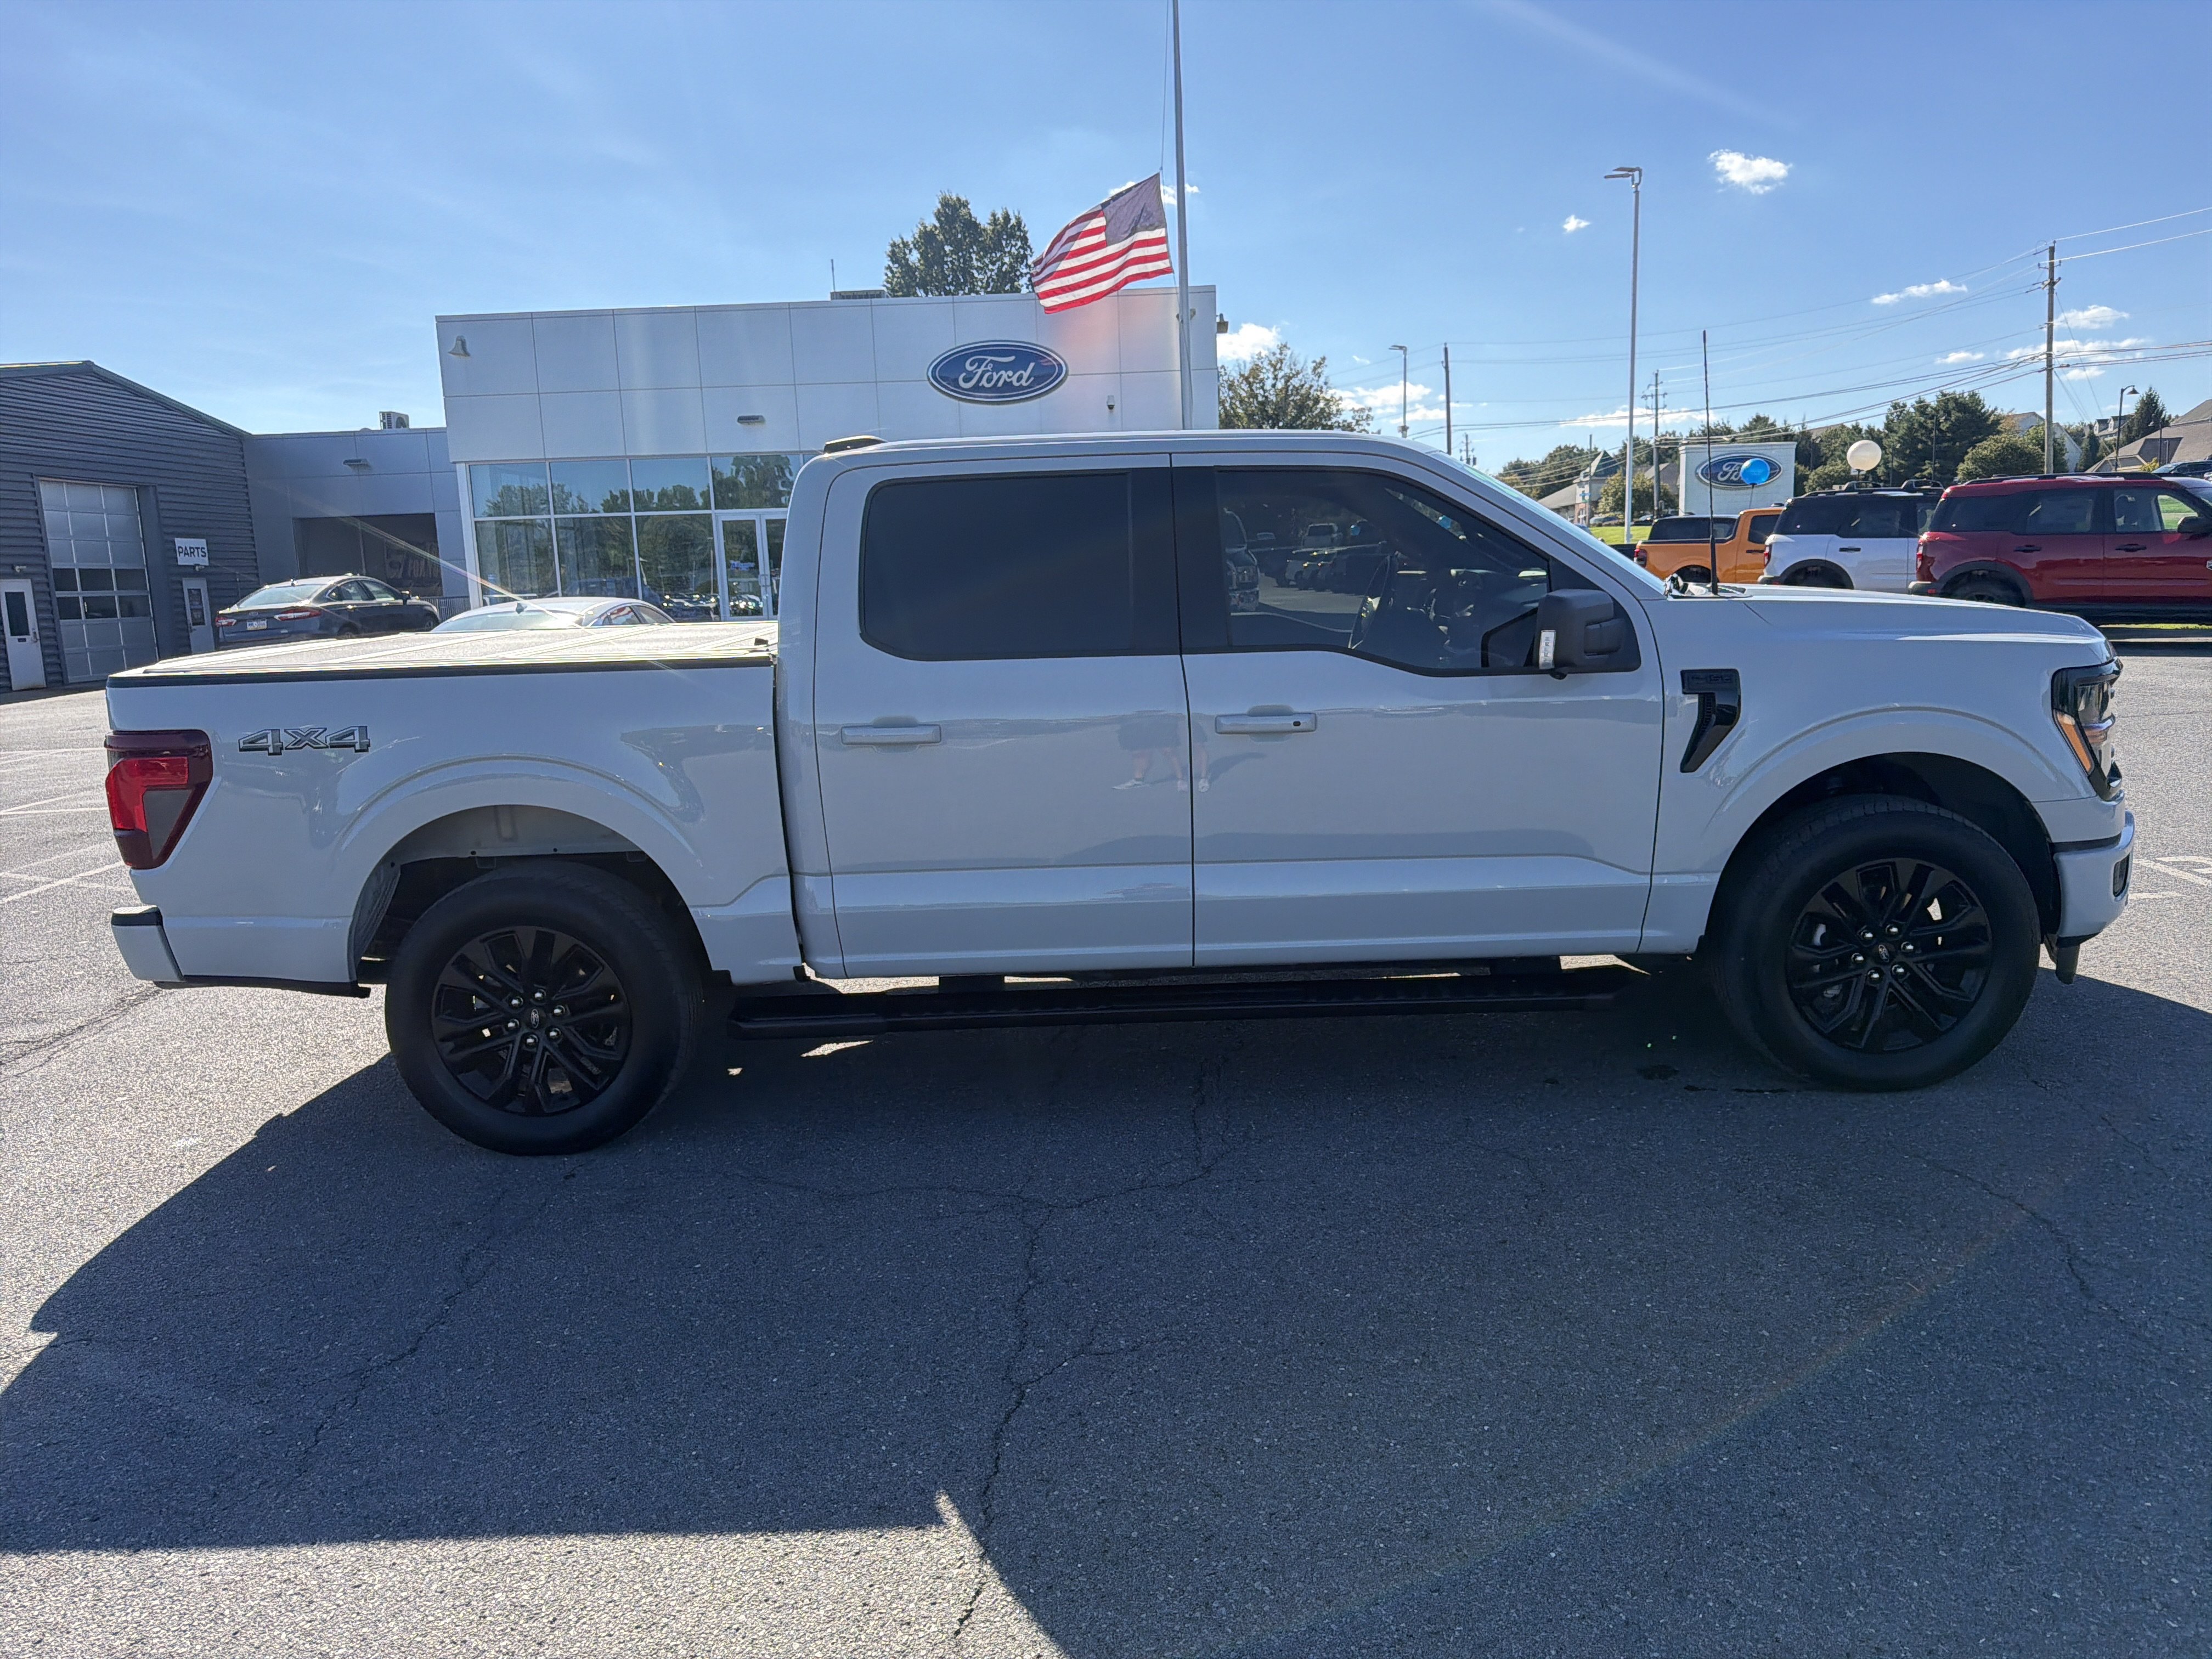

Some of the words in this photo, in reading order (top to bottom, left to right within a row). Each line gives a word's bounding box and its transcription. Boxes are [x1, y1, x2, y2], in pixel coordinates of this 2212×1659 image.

[958, 356, 1036, 388] Ford
[1717, 461, 1743, 481] Fo
[177, 545, 207, 558] PARTS
